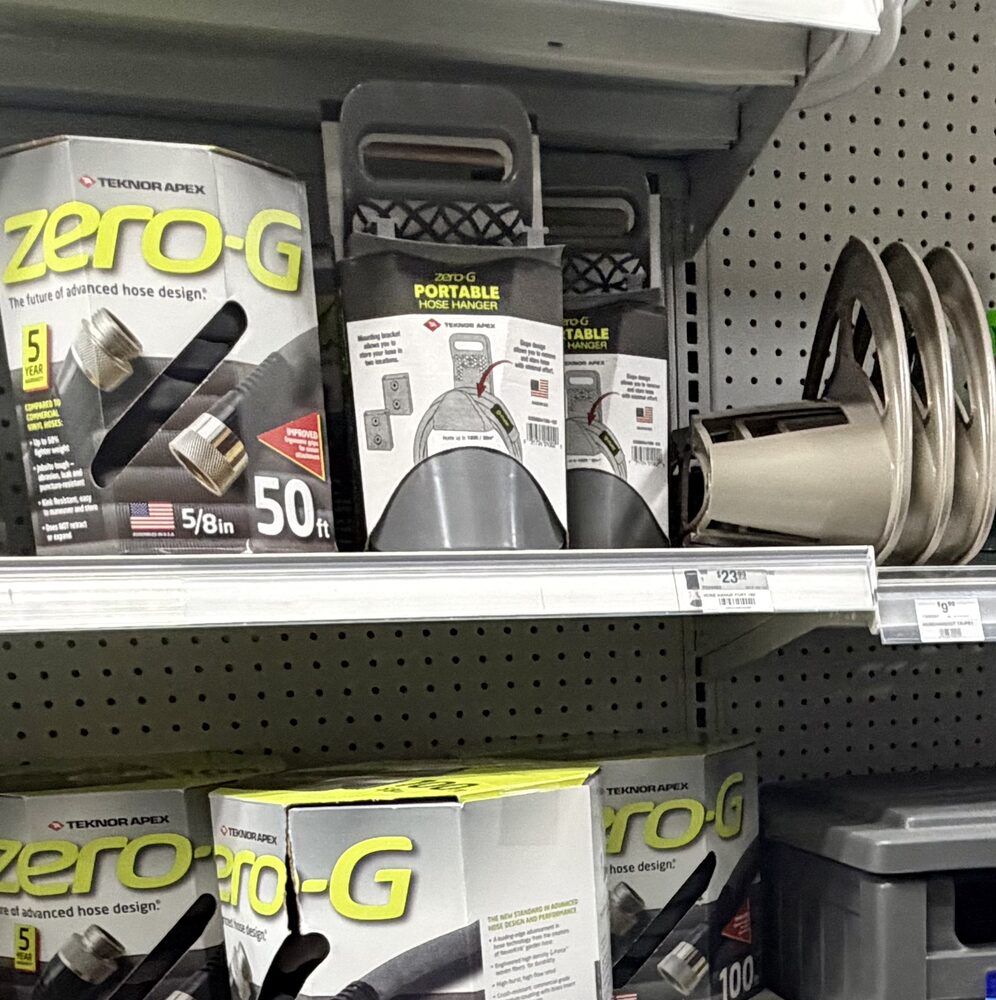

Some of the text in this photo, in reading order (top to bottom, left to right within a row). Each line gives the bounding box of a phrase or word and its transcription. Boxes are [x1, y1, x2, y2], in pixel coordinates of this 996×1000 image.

[98, 177, 205, 195] TEKNOR APEX
[3, 201, 303, 292] zero-G
[8, 296, 24, 310] The
[26, 289, 53, 306] future
[55, 286, 64, 299] of
[66, 282, 119, 297] advanced
[123, 284, 154, 298] hose
[414, 284, 500, 299] PORTABLE
[419, 300, 498, 310] HOSE HANGER
[563, 328, 609, 340] TABLE
[28, 329, 40, 363] 5
[25, 364, 43, 376] YEAR
[286, 428, 318, 439] IMPROVED
[181, 508, 234, 535] 5/8in
[606, 782, 689, 795] TEKNOR APEX
[66, 814, 170, 831] TEKNOR APEX
[228, 827, 278, 845] TEKNOR APEX
[609, 863, 635, 874] hose
[22, 904, 74, 920] advanced
[77, 903, 109, 917] hose
[18, 927, 30, 950] 5
